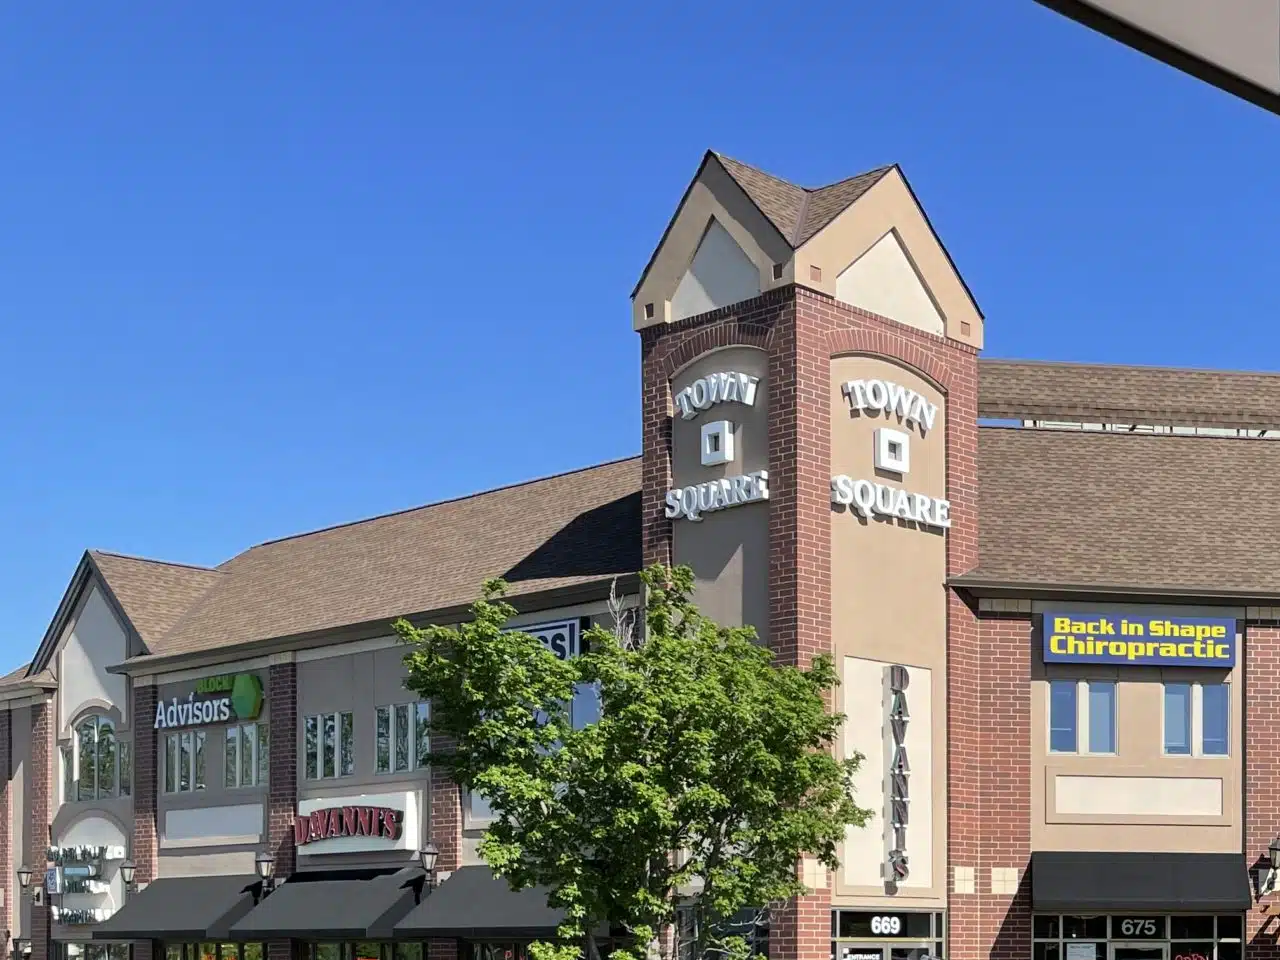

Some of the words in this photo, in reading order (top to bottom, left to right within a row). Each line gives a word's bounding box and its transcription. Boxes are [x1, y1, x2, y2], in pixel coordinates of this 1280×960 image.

[675, 371, 760, 420] TOWN
[842, 379, 938, 430] TOWN
[665, 470, 769, 521] SQUARE
[831, 474, 951, 528] SQUARE
[1050, 635, 1230, 660] Chiropractic
[1054, 617, 1116, 635] Back
[1121, 619, 1144, 636] in
[1149, 620, 1227, 641] Shape
[154, 691, 230, 728] Advisors
[871, 916, 900, 934] 669
[1121, 919, 1156, 935] 675
